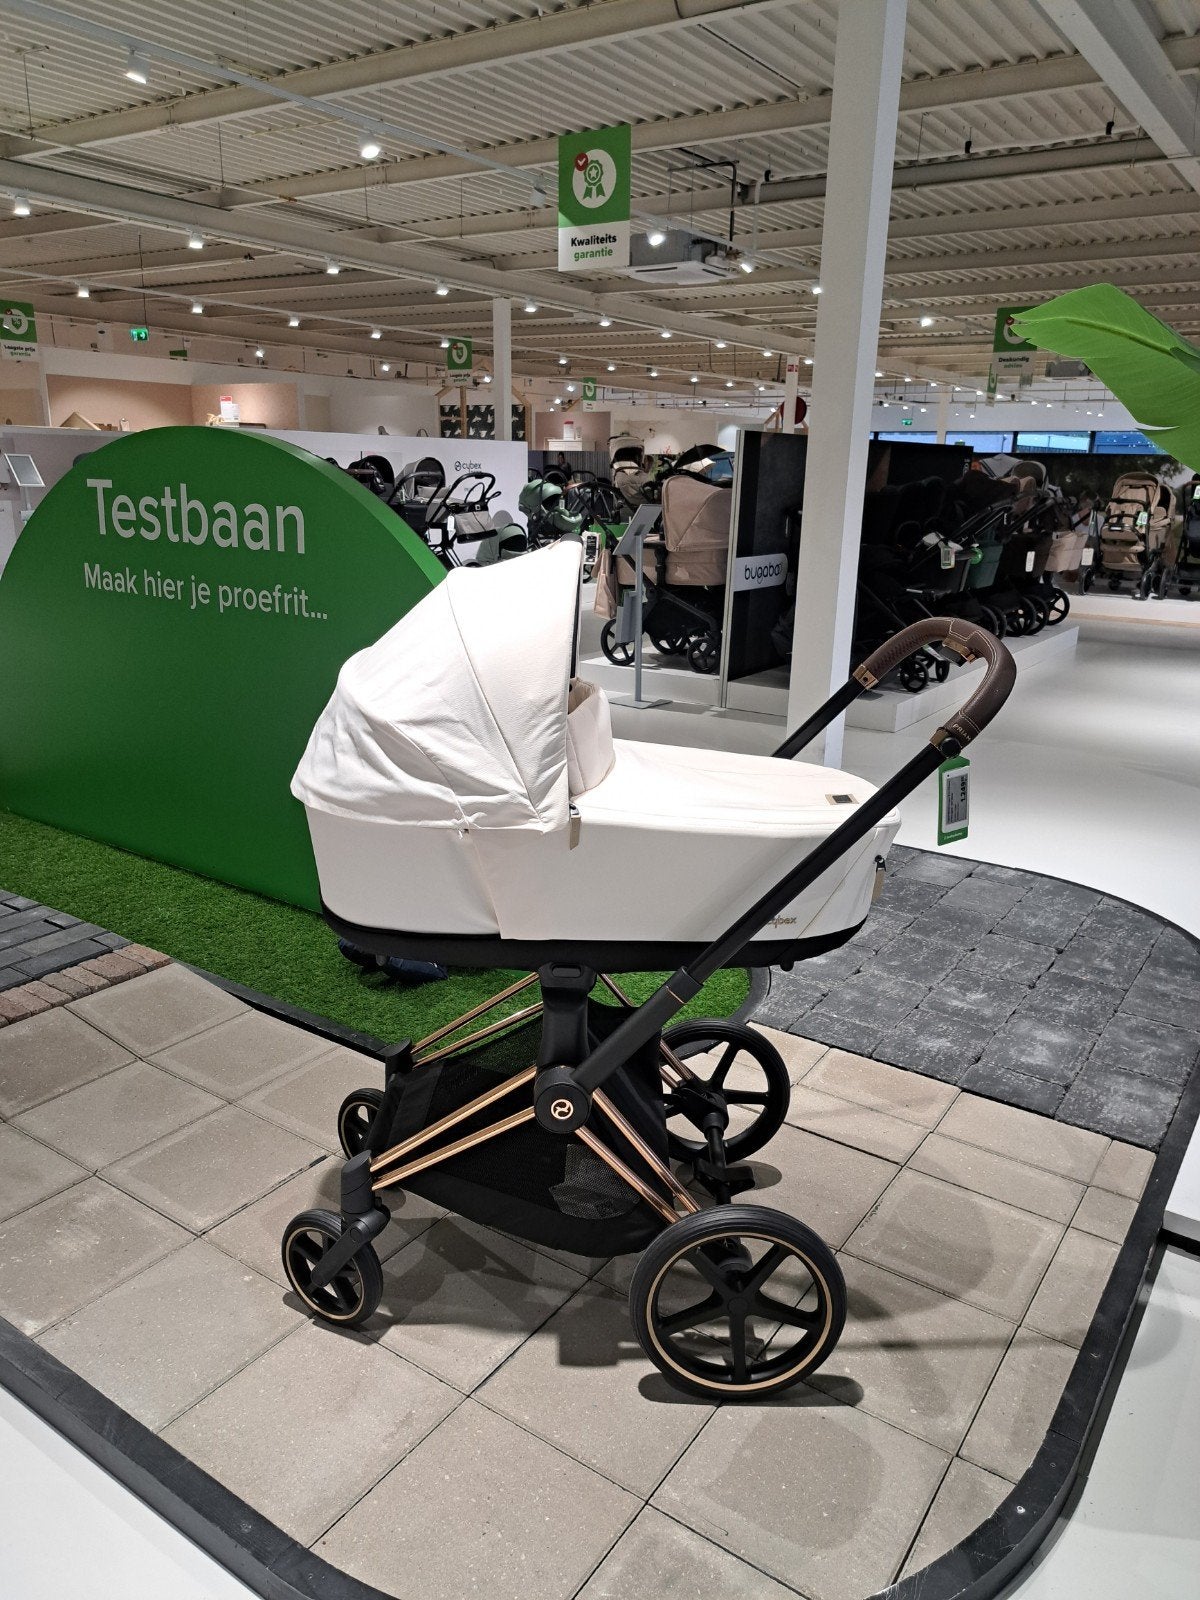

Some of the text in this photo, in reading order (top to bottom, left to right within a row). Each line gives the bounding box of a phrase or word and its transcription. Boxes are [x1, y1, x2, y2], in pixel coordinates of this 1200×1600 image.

[571, 234, 617, 247] Kwaliteits
[574, 247, 613, 261] garantie
[462, 460, 482, 474] cybex
[86, 478, 306, 555] Testbaan
[744, 562, 783, 584] bugaboo
[84, 562, 328, 620] Maak hier je proefrit...
